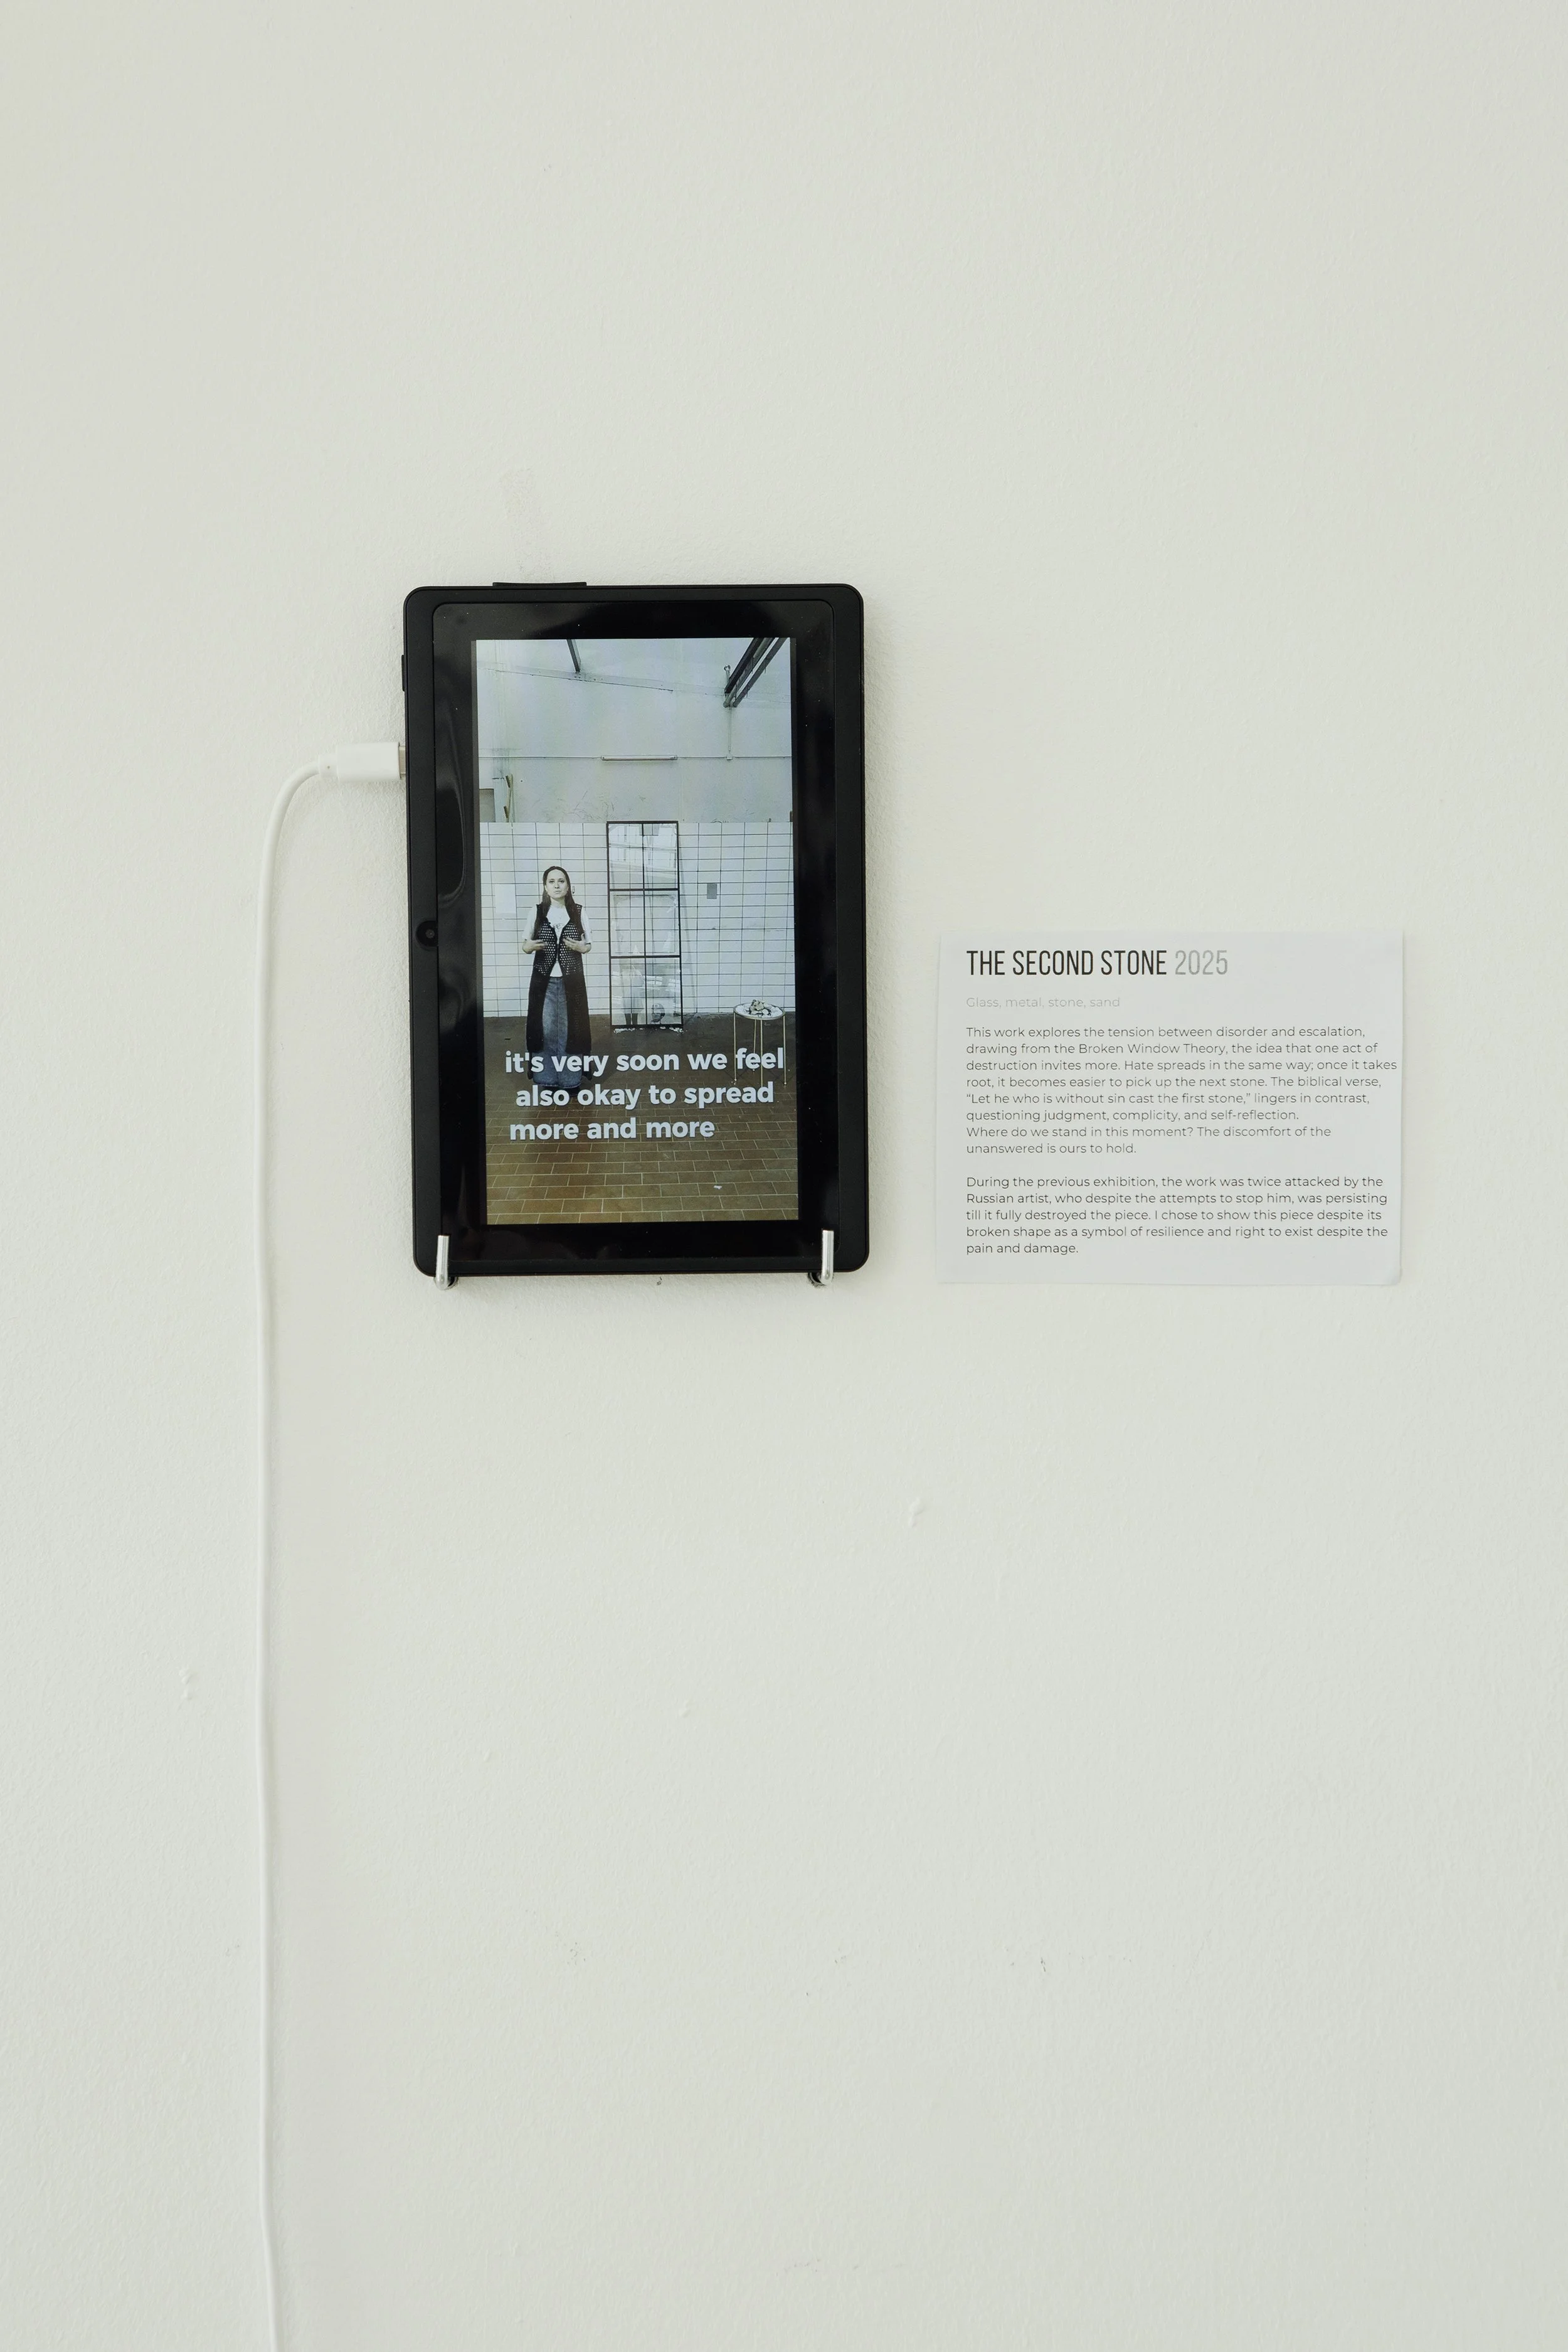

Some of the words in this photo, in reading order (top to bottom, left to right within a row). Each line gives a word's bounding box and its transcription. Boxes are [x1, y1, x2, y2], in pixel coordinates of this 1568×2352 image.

[966, 950, 1006, 976] THE
[1012, 950, 1094, 976] SECOND
[1100, 949, 1167, 976] STONE
[1175, 949, 1228, 976] 2025
[966, 996, 1002, 1009] Glass,
[1005, 997, 1044, 1009] metal,
[1048, 998, 1086, 1009] stone,
[1089, 996, 1121, 1008] sand
[965, 1026, 992, 1038] This
[993, 1026, 1025, 1038] work
[1028, 1026, 1081, 1040] explores
[1083, 1026, 1105, 1037] the
[1107, 1026, 1155, 1037] tension
[1158, 1026, 1212, 1037] between
[1216, 1026, 1268, 1037] disorder
[1271, 1026, 1295, 1037] and
[1298, 1026, 1365, 1038] escalation,
[966, 1043, 1017, 1056] drawing
[1020, 1043, 1051, 1054] from
[1054, 1043, 1076, 1054] the
[1079, 1043, 1123, 1054] Broken
[1127, 1043, 1180, 1054] Window
[1182, 1043, 1228, 1056] Theory,
[1231, 1043, 1253, 1053] the
[1256, 1043, 1283, 1053] idea
[1285, 1042, 1312, 1053] that
[1315, 1045, 1339, 1053] one
[1342, 1044, 1362, 1053] act
[1365, 1042, 1379, 1053] of
[506, 1050, 544, 1073] it's
[551, 1055, 609, 1077] very
[616, 1054, 679, 1071] soon
[687, 1053, 728, 1070] we
[735, 1047, 783, 1069] feel
[966, 1060, 1037, 1071] destruction
[1041, 1060, 1082, 1070] invites
[1085, 1062, 1121, 1070] more.
[1125, 1060, 1154, 1070] Hate
[1157, 1060, 1206, 1072] spreads
[1209, 1060, 1221, 1070] in
[1224, 1060, 1245, 1070] the
[1248, 1062, 1283, 1070] same
[1285, 1062, 1314, 1072] way;
[1316, 1062, 1348, 1070] once
[1352, 1059, 1360, 1070] it
[1362, 1059, 1397, 1070] takes
[967, 1078, 994, 1089] root,
[998, 1077, 1005, 1087] it
[1009, 1076, 1066, 1087] becomes
[1069, 1076, 1106, 1087] easier
[1109, 1077, 1123, 1087] to
[1126, 1076, 1152, 1089] pick
[1155, 1078, 1172, 1089] up
[1175, 1076, 1196, 1087] the
[1199, 1077, 1227, 1087] next
[1229, 1078, 1268, 1087] stone.
[1270, 1076, 1295, 1087] The
[1298, 1076, 1342, 1087] biblical
[1345, 1078, 1381, 1088] verse,
[516, 1085, 569, 1107] also
[577, 1083, 641, 1110] okay
[649, 1085, 676, 1104] to
[684, 1081, 773, 1109] spread
[994, 1093, 1010, 1104] he
[1012, 1093, 1040, 1104] who
[1043, 1093, 1053, 1104] is
[1055, 1093, 1104, 1104] without
[1108, 1093, 1125, 1104] sin
[1128, 1094, 1155, 1104] cast
[1157, 1093, 1179, 1104] the
[1181, 1092, 1205, 1104] first
[1254, 1092, 1297, 1105] lingers
[1300, 1092, 1311, 1103] in
[1315, 1094, 1370, 1105] contrast,
[966, 1109, 1041, 1123] questioning
[1042, 1109, 1110, 1123] judgment,
[1112, 1109, 1181, 1122] complicity,
[1184, 1109, 1207, 1120] and
[1210, 1109, 1299, 1120] self-reflection.
[510, 1123, 579, 1140] more
[587, 1117, 636, 1139] and
[646, 1121, 715, 1138] more
[966, 1126, 1009, 1137] Where
[1011, 1126, 1027, 1137] do
[1030, 1129, 1049, 1137] we
[1052, 1126, 1087, 1137] stand
[1091, 1126, 1102, 1137] in
[1105, 1126, 1129, 1137] this
[1132, 1127, 1194, 1137] moment?
[1196, 1126, 1220, 1137] The
[1223, 1125, 1291, 1137] discomfort
[1295, 1125, 1308, 1137] of
[1310, 1125, 1332, 1137] the
[967, 1142, 1043, 1154] unanswered
[1047, 1142, 1056, 1154] is
[1059, 1145, 1087, 1154] ours
[1089, 1144, 1103, 1154] to
[1106, 1142, 1136, 1154] hold.
[967, 1176, 1009, 1189] During
[1012, 1176, 1034, 1187] the
[1037, 1176, 1091, 1189] previous
[1093, 1176, 1158, 1188] exhibition,
[1161, 1176, 1183, 1187] the
[1185, 1176, 1217, 1187] work
[1219, 1178, 1244, 1187] was
[1247, 1176, 1281, 1187] twice
[1285, 1176, 1340, 1187] attacked
[1344, 1176, 1359, 1189] by
[1362, 1176, 1384, 1187] the
[967, 1193, 1014, 1204] Russian
[1017, 1193, 1052, 1205] artist,
[1054, 1193, 1083, 1203] who
[1085, 1193, 1132, 1206] despite
[1135, 1193, 1157, 1203] the
[1159, 1194, 1217, 1206] attempts
[1219, 1194, 1233, 1203] to
[1236, 1194, 1264, 1206] stop
[1267, 1192, 1295, 1205] him,
[1297, 1195, 1323, 1203] was
[1325, 1192, 1387, 1206] persisting
[965, 1210, 981, 1220] till
[984, 1210, 993, 1220] it
[995, 1209, 1022, 1223] fully
[1024, 1209, 1087, 1223] destroyed
[1090, 1209, 1111, 1220] the
[1115, 1209, 1151, 1222] piece.
[1155, 1210, 1158, 1220] I
[1161, 1209, 1198, 1220] chose
[1200, 1211, 1214, 1220] to
[1217, 1209, 1251, 1220] show
[1253, 1209, 1277, 1220] this
[1279, 1209, 1314, 1222] piece
[1316, 1209, 1364, 1222] despite
[1367, 1209, 1382, 1220] its
[967, 1226, 1010, 1237] broken
[1013, 1226, 1051, 1239] shape
[1054, 1228, 1068, 1237] as
[1071, 1228, 1078, 1237] a
[1081, 1226, 1127, 1239] symbol
[1130, 1226, 1143, 1237] of
[1146, 1226, 1204, 1237] resilience
[1207, 1226, 1231, 1237] and
[1235, 1226, 1265, 1239] right
[1268, 1227, 1282, 1237] to
[1285, 1226, 1314, 1237] exist
[1316, 1226, 1364, 1239] despite
[1366, 1226, 1388, 1237] the
[967, 1242, 993, 1255] pain
[996, 1242, 1020, 1253] and
[1024, 1242, 1079, 1256] damage.
